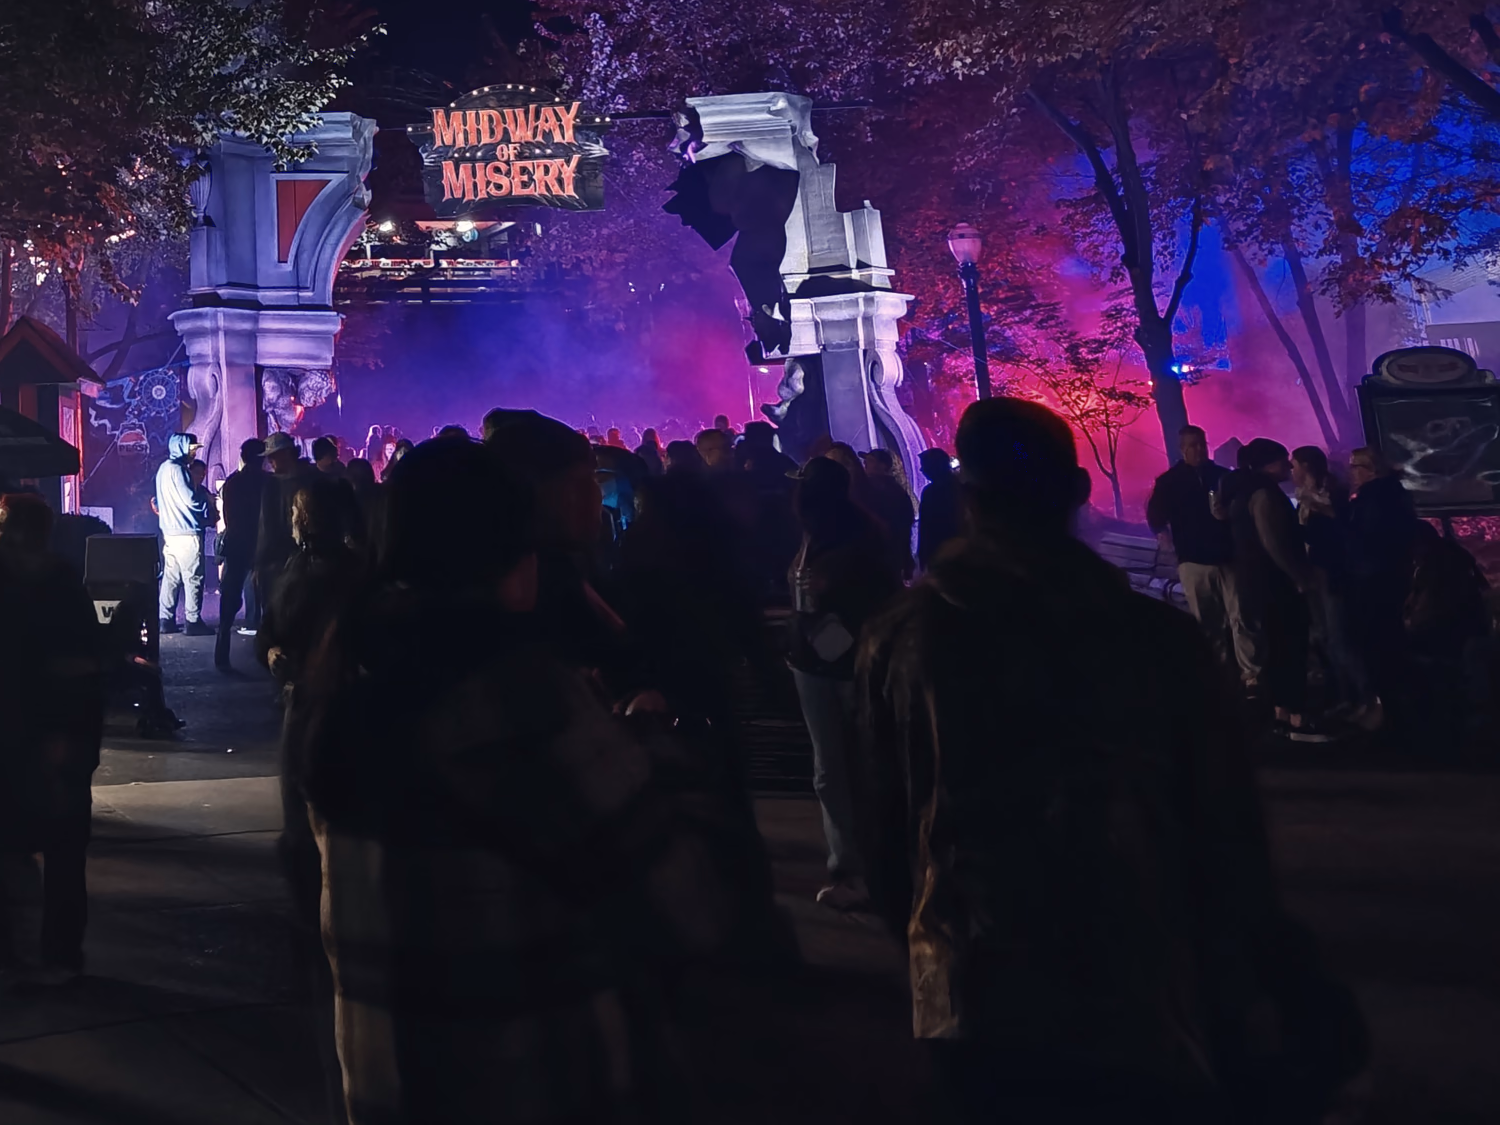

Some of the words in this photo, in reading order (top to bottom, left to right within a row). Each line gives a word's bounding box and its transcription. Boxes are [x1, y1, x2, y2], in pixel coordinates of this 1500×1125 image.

[432, 101, 581, 150] MIDWAY
[496, 144, 521, 161] OF
[441, 154, 582, 202] MISERY
